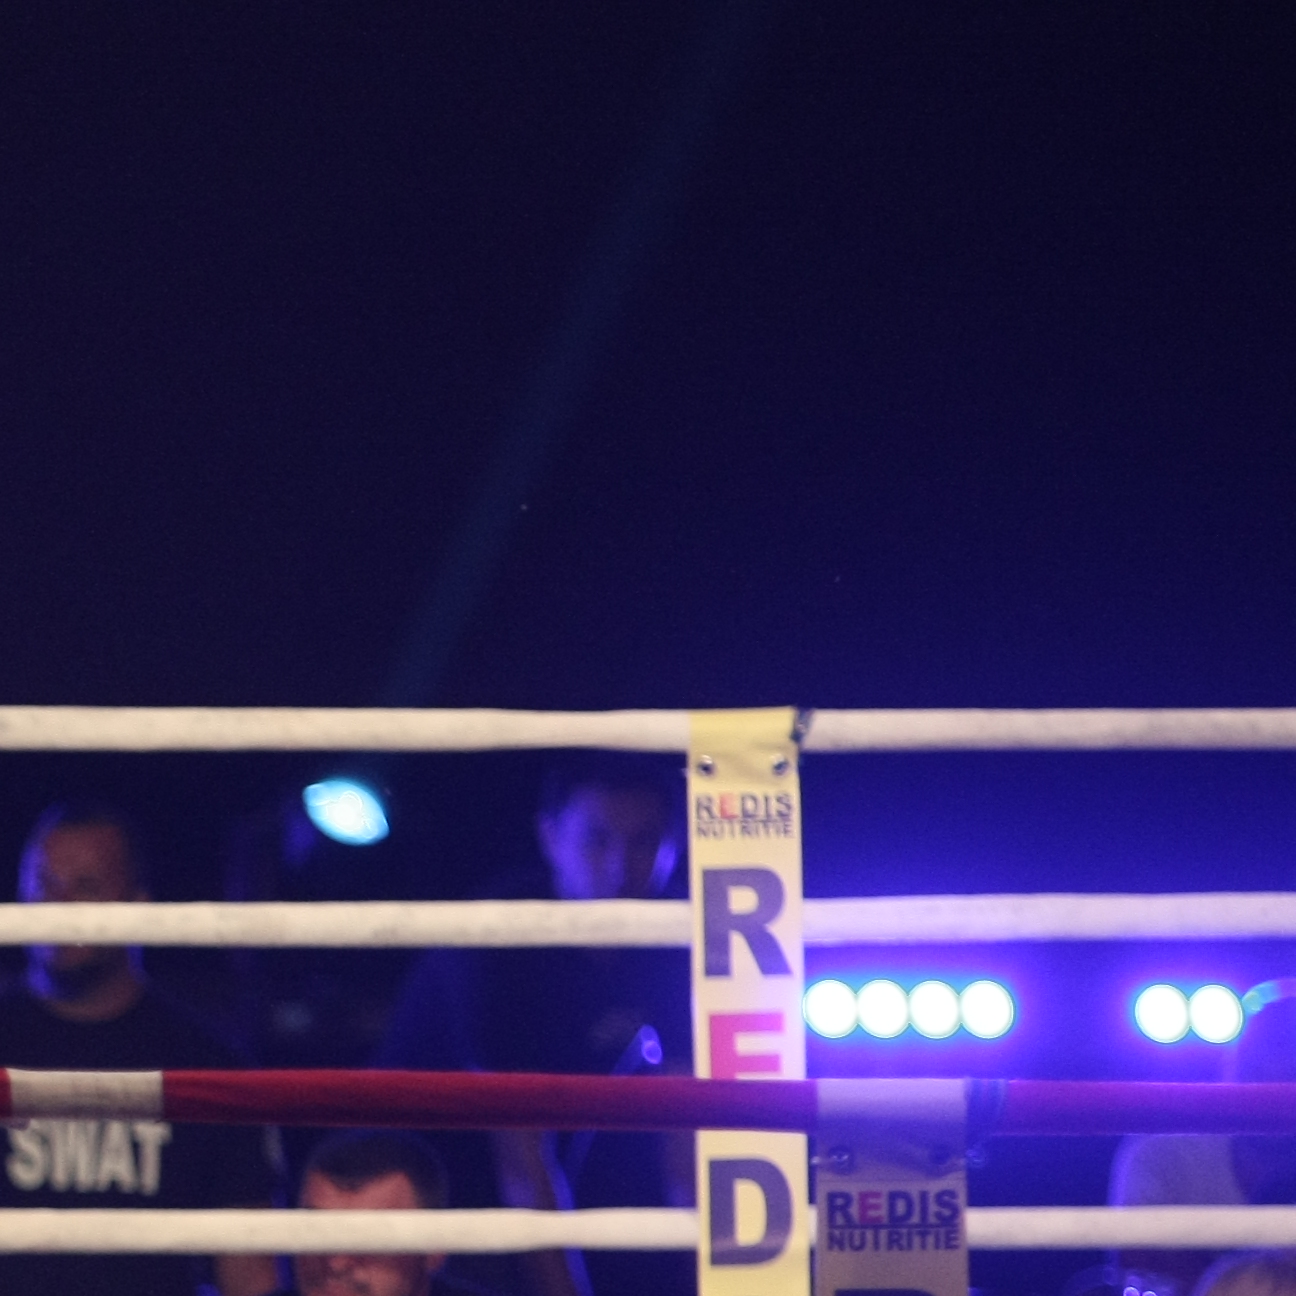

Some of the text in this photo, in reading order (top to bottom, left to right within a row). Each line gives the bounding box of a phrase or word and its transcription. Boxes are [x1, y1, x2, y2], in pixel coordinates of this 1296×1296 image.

[696, 792, 793, 818] REDIS
[696, 819, 795, 839] NUTRITIE
[6, 1119, 172, 1196] SWAT
[826, 1189, 961, 1225] REDIS
[827, 1227, 960, 1252] NUTRITIE
